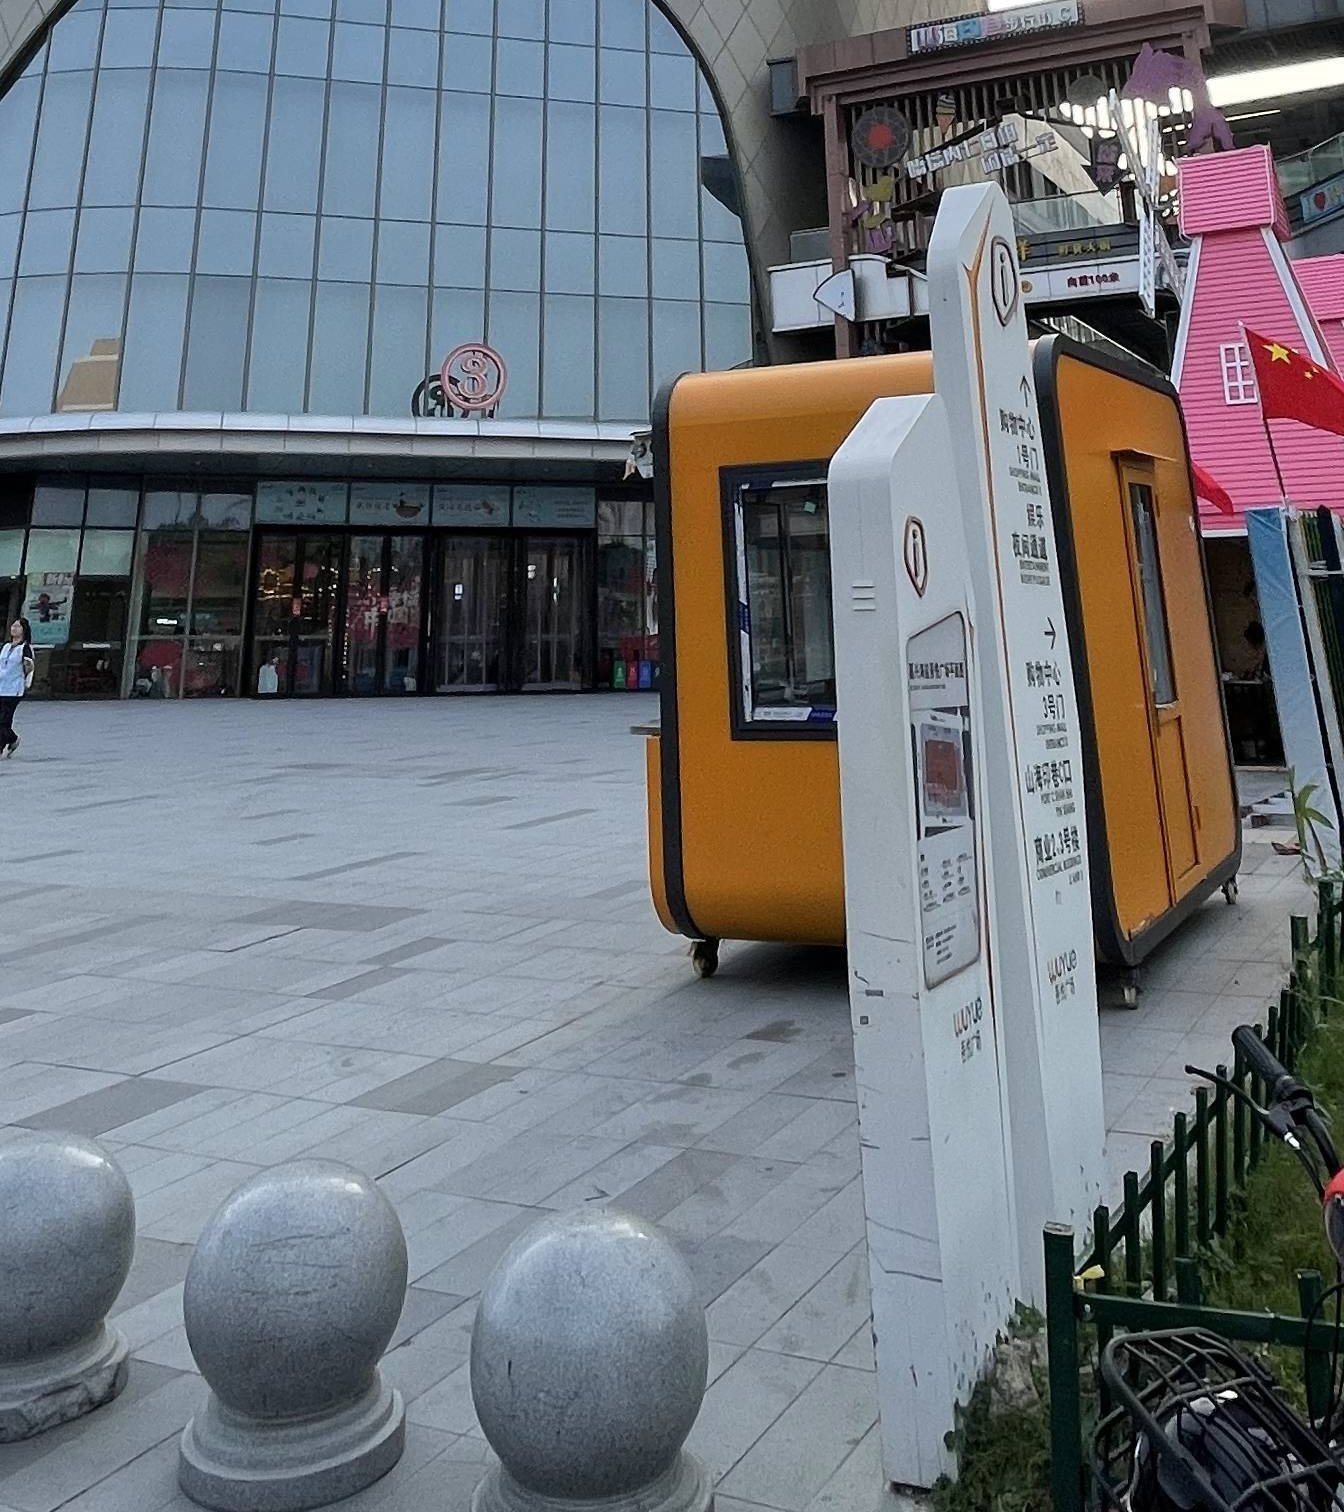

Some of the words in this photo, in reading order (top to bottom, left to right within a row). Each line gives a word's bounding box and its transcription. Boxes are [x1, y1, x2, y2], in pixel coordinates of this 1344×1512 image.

[999, 407, 1035, 441] 购物中心
[1025, 660, 1062, 689] 购物中心
